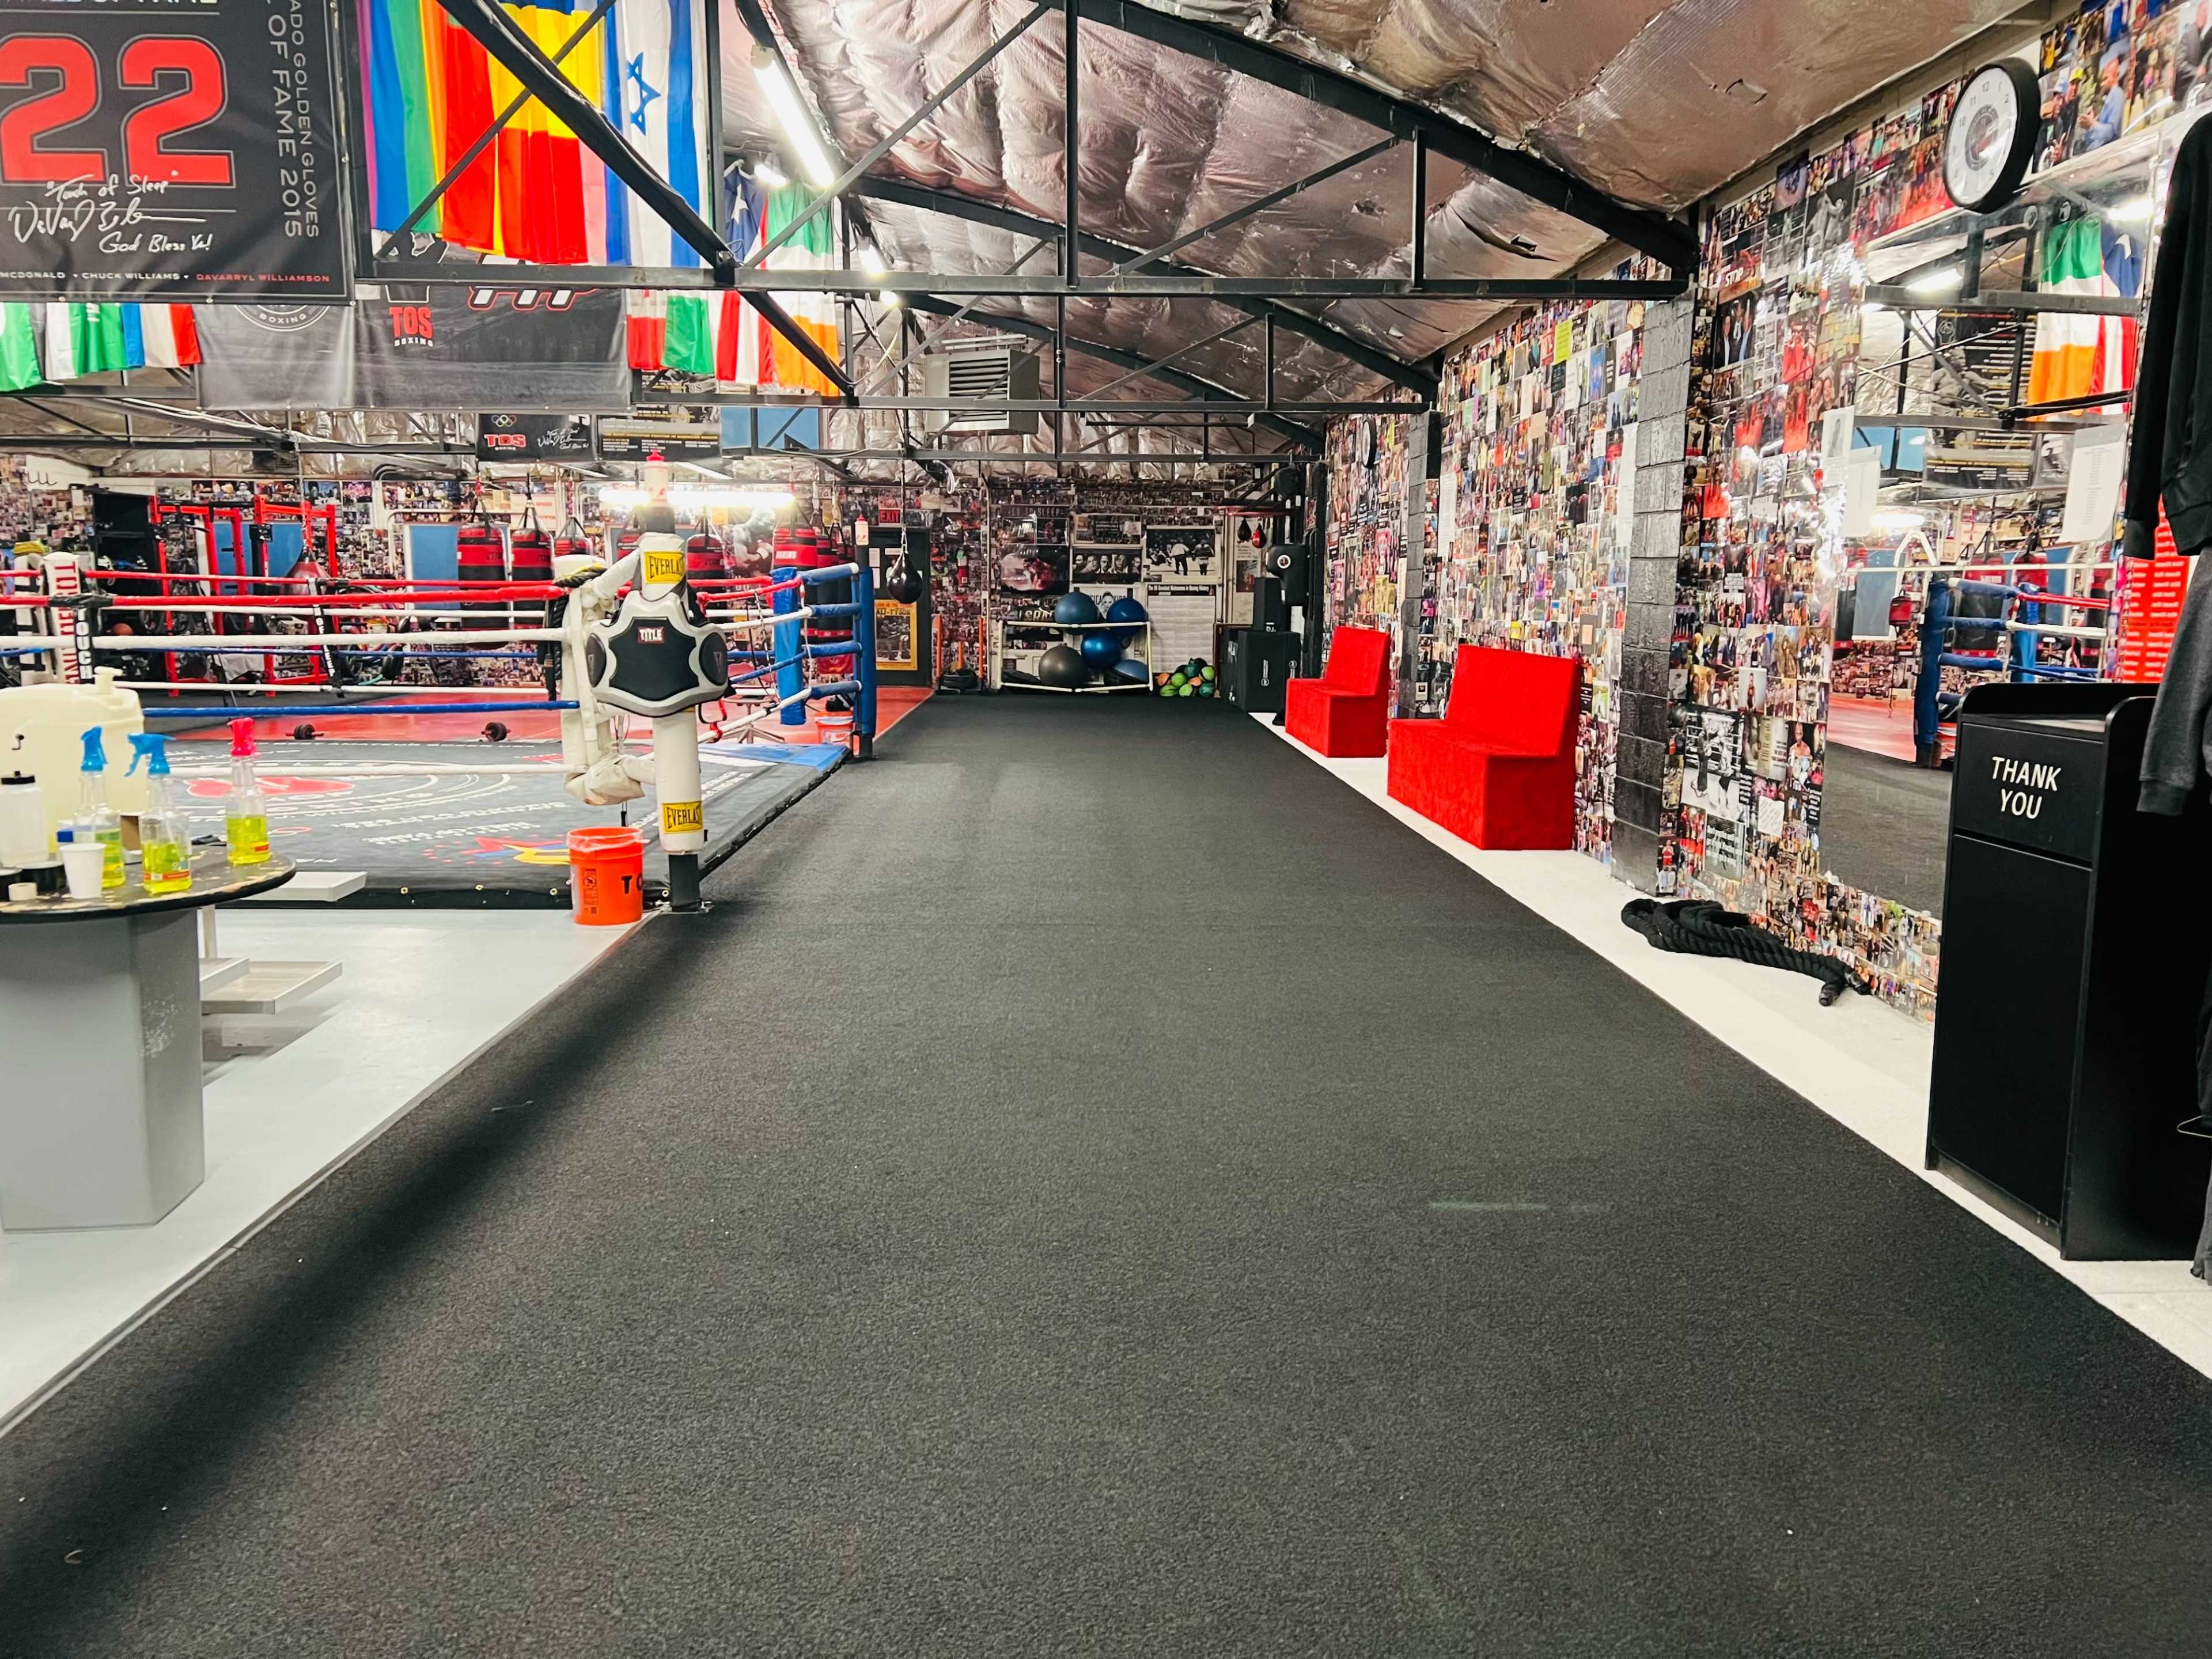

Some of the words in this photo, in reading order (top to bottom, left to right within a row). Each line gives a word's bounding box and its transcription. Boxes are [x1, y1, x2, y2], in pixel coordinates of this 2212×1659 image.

[268, 16, 288, 59] OF
[272, 69, 296, 157] FAME
[293, 53, 312, 145] GOLDEN
[281, 170, 302, 237] 2015
[301, 153, 319, 237] GLOVES
[99, 232, 142, 253] God
[258, 274, 330, 282] WILLIAMSON
[260, 313, 306, 324] BOXING
[389, 306, 433, 339] TOS
[484, 434, 526, 448] TOS
[880, 509, 900, 523] EXIT
[649, 555, 685, 578] EVERLAS
[639, 628, 662, 642] TITLE
[1992, 756, 2062, 791] THANK
[666, 804, 702, 829] EVERLAS
[2001, 788, 2043, 819] YOU
